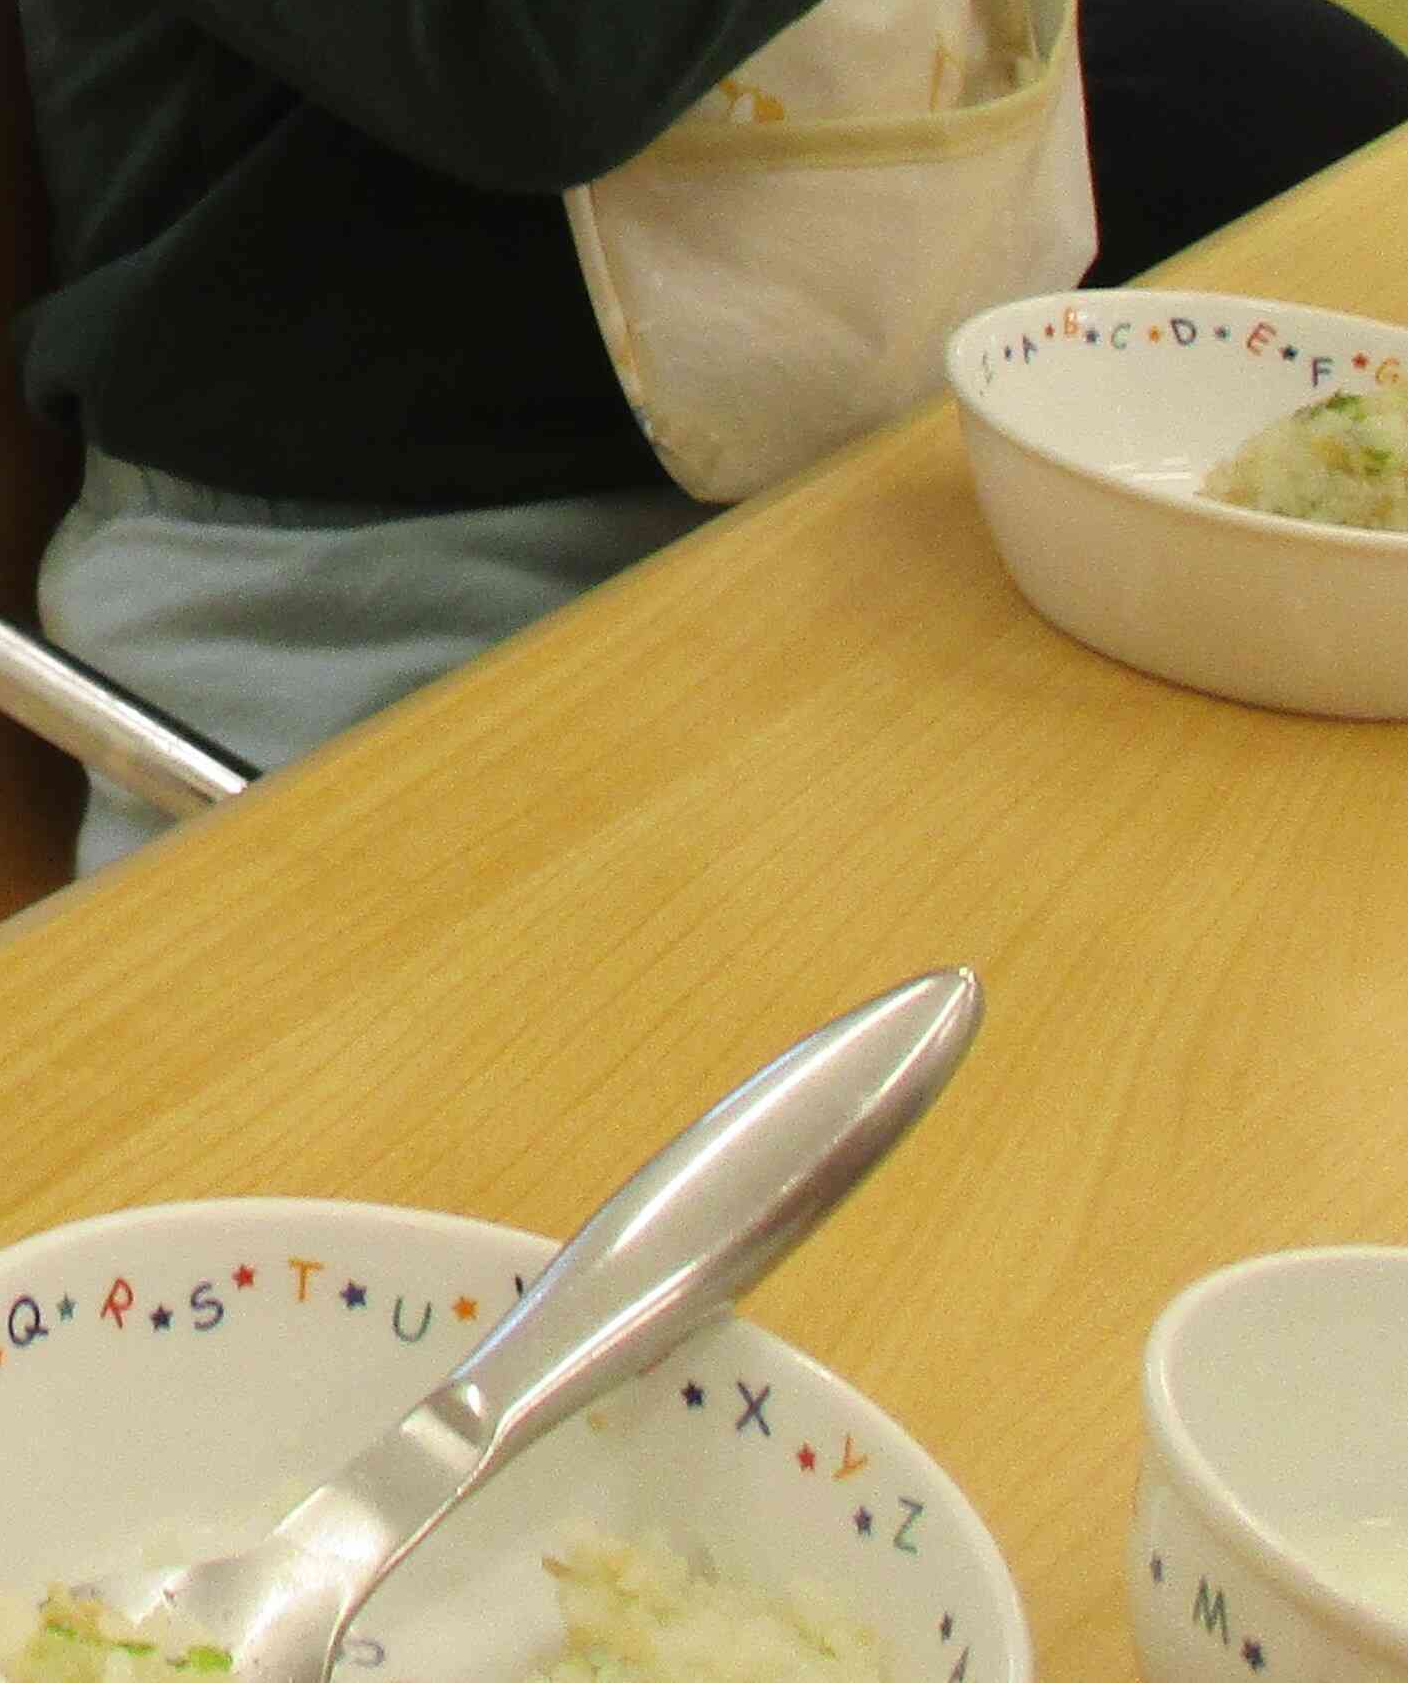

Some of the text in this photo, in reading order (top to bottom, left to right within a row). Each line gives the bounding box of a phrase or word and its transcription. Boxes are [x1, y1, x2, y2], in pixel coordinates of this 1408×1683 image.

[1110, 322, 1132, 350] C
[1170, 318, 1197, 347] D
[1246, 321, 1277, 357] E
[1310, 356, 1334, 388] F
[8, 1294, 50, 1347] Q
[99, 1276, 135, 1330] R
[189, 1281, 225, 1331] S
[287, 1255, 325, 1303] T
[392, 1295, 433, 1343] U
[735, 1380, 772, 1438] X
[832, 1432, 869, 1482] Y
[893, 1495, 925, 1555] Z
